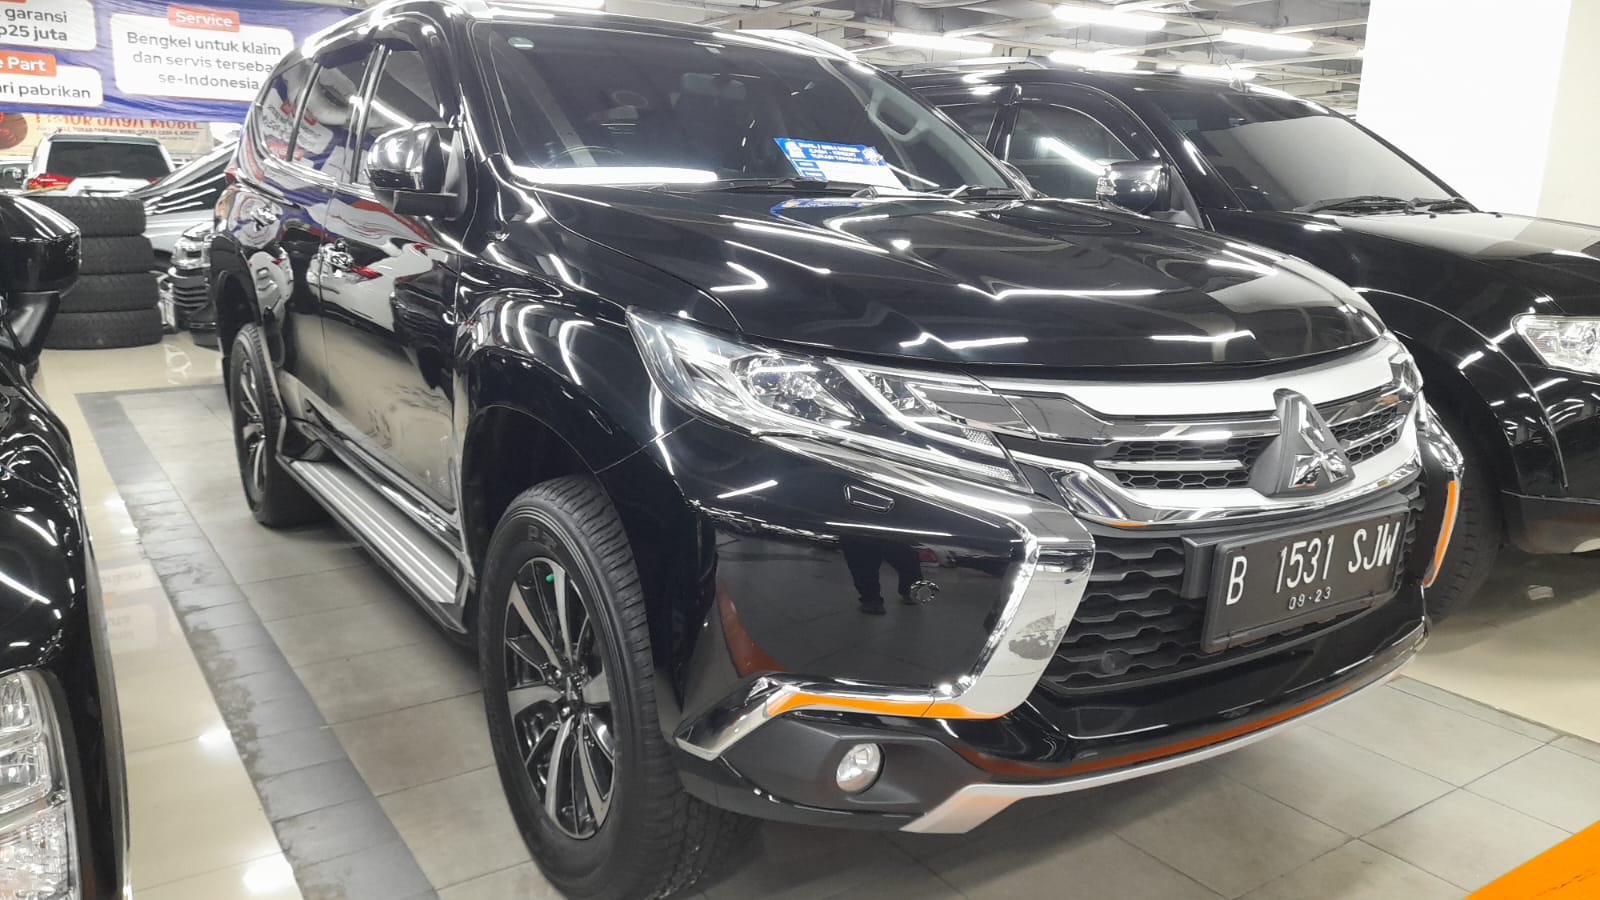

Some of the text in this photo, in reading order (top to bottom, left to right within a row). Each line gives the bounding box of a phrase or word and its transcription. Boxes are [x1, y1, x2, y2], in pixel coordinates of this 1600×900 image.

[5, 8, 68, 23] garansi
[175, 11, 233, 28] Service
[33, 26, 68, 41] juta
[127, 31, 281, 56] Bengkel untuk klaim
[7, 56, 46, 72] Part
[133, 51, 274, 73] dan servis terseba
[158, 73, 259, 90] se-Indonesia
[18, 84, 91, 98] pabrikan
[1226, 521, 1401, 605] B 1531 SJW
